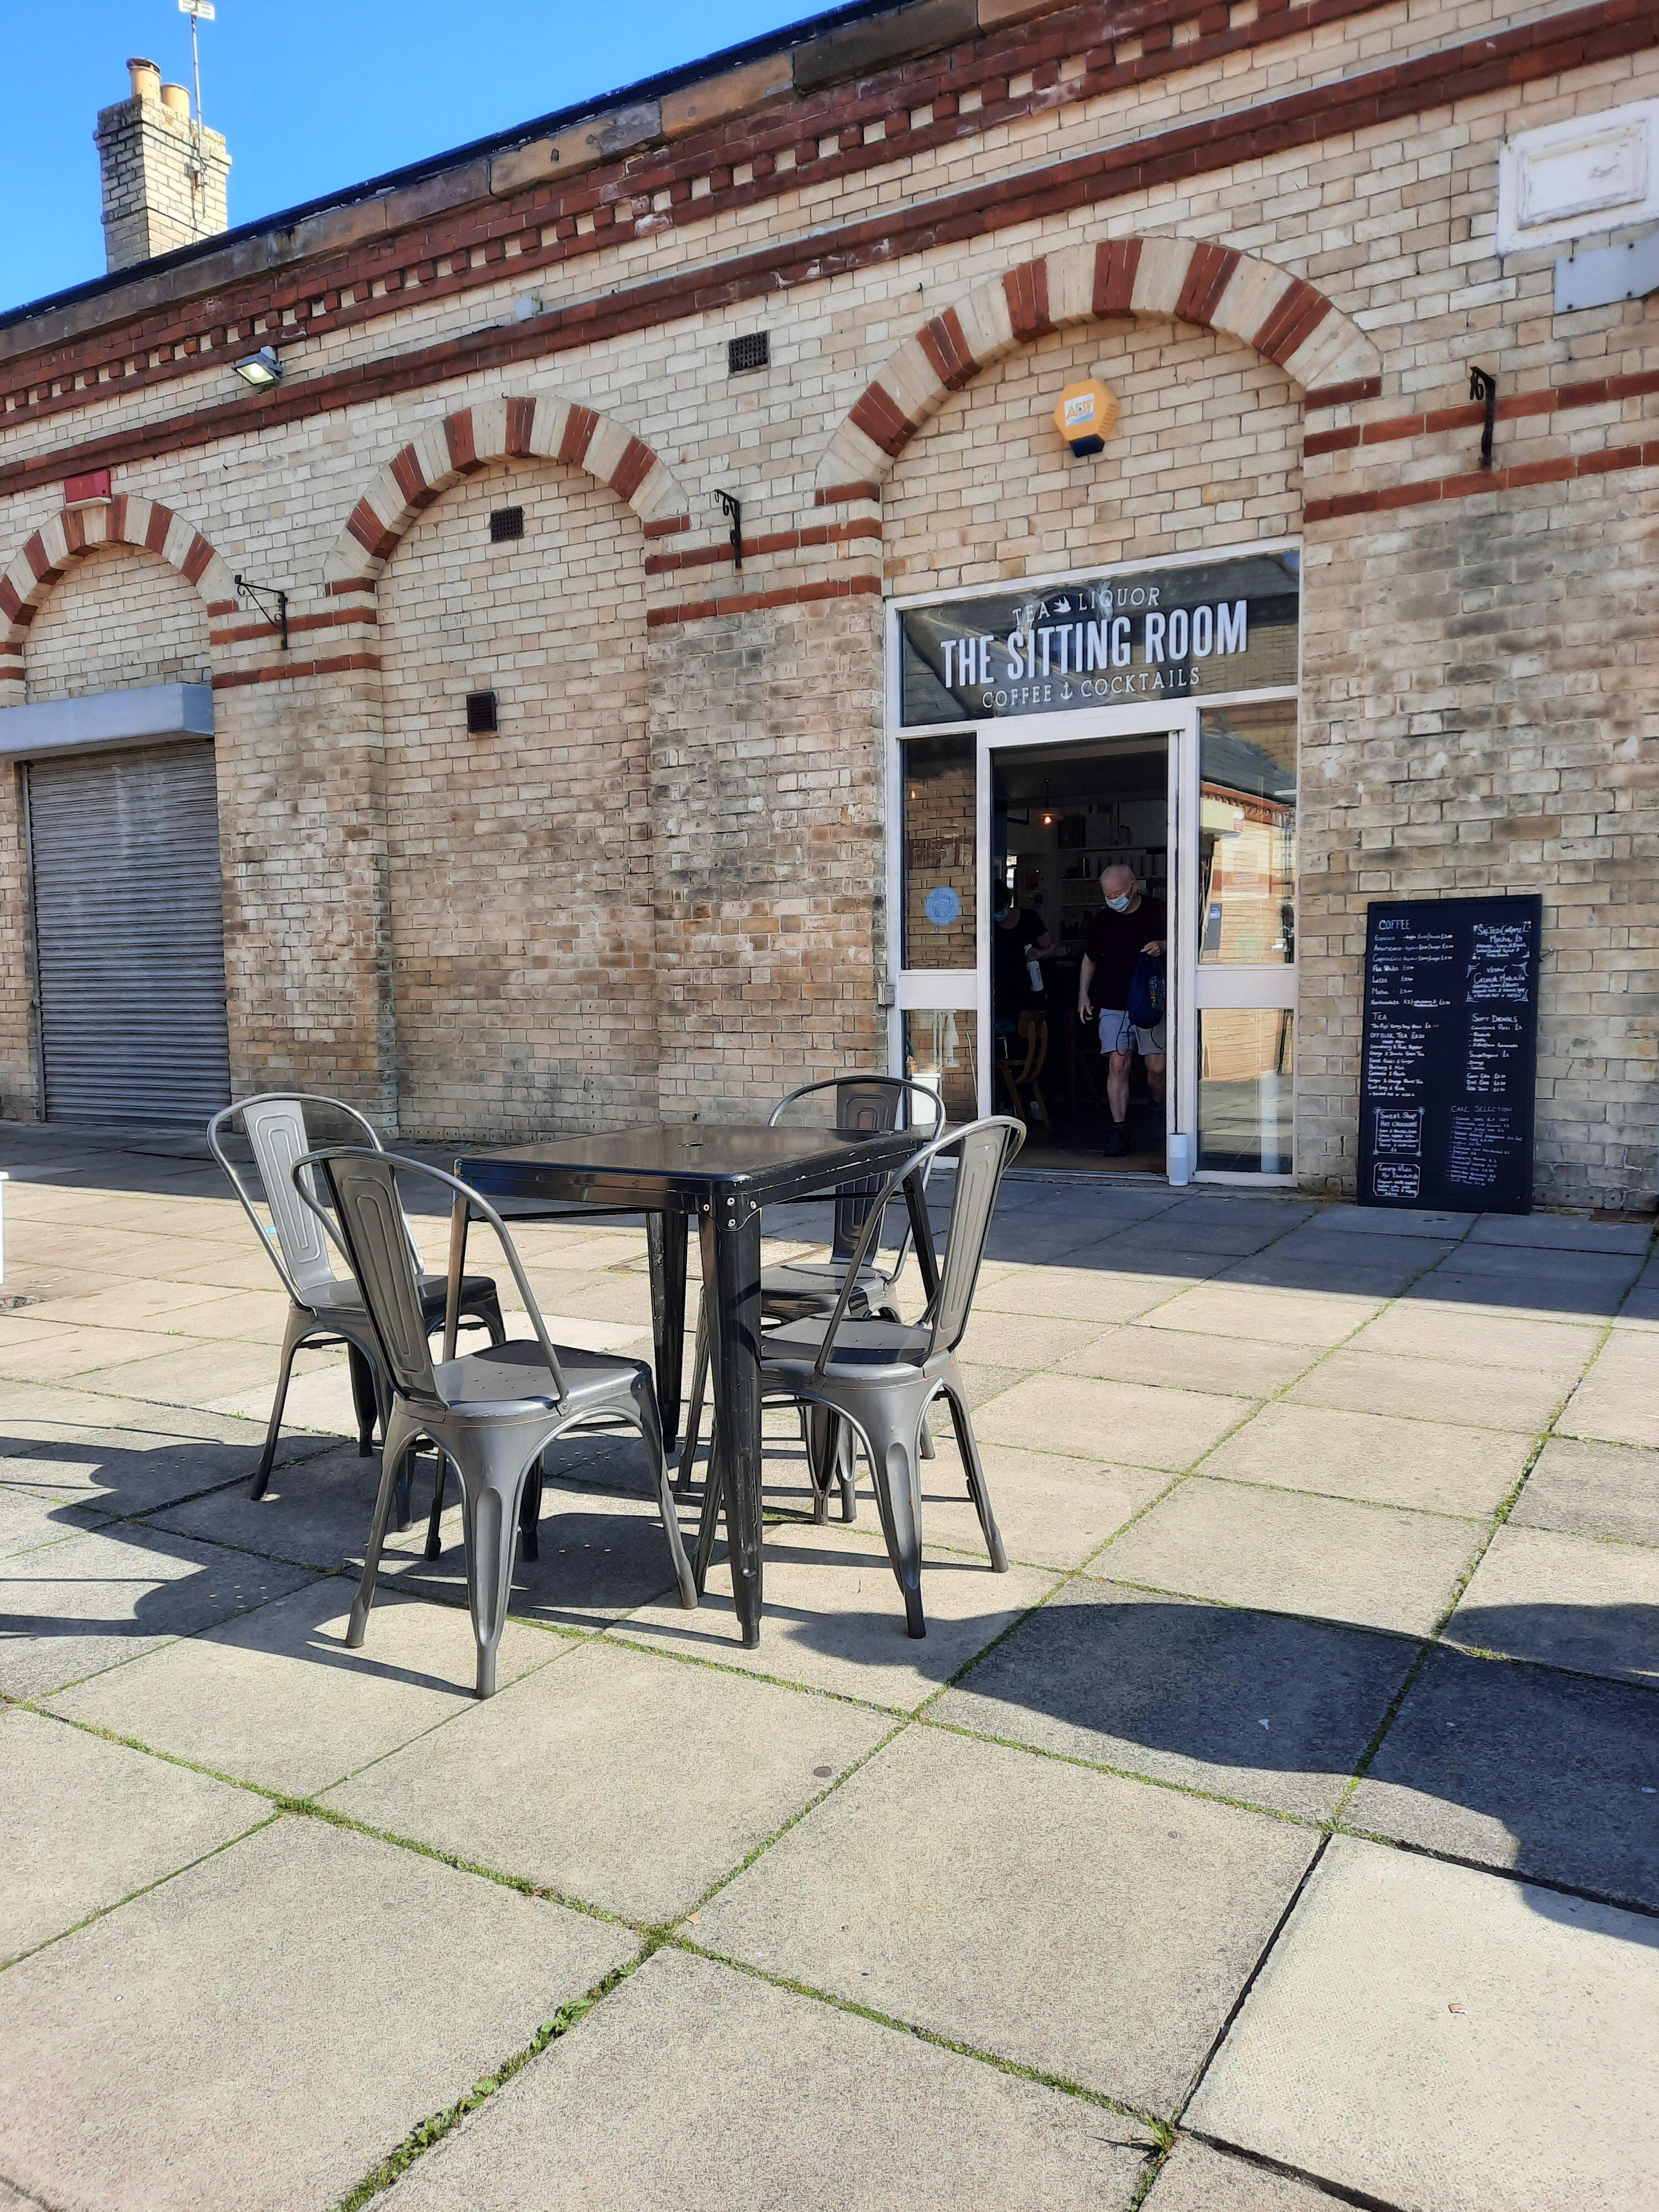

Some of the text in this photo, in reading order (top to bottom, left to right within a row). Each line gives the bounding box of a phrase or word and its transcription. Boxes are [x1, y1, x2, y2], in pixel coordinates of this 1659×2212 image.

[1012, 587, 1160, 626] TEA LIQUOR
[940, 600, 1248, 688] THE SITTING ROOM
[982, 667, 1200, 708] COFFEE COCKTAILS
[1379, 919, 1411, 930] COFFEE
